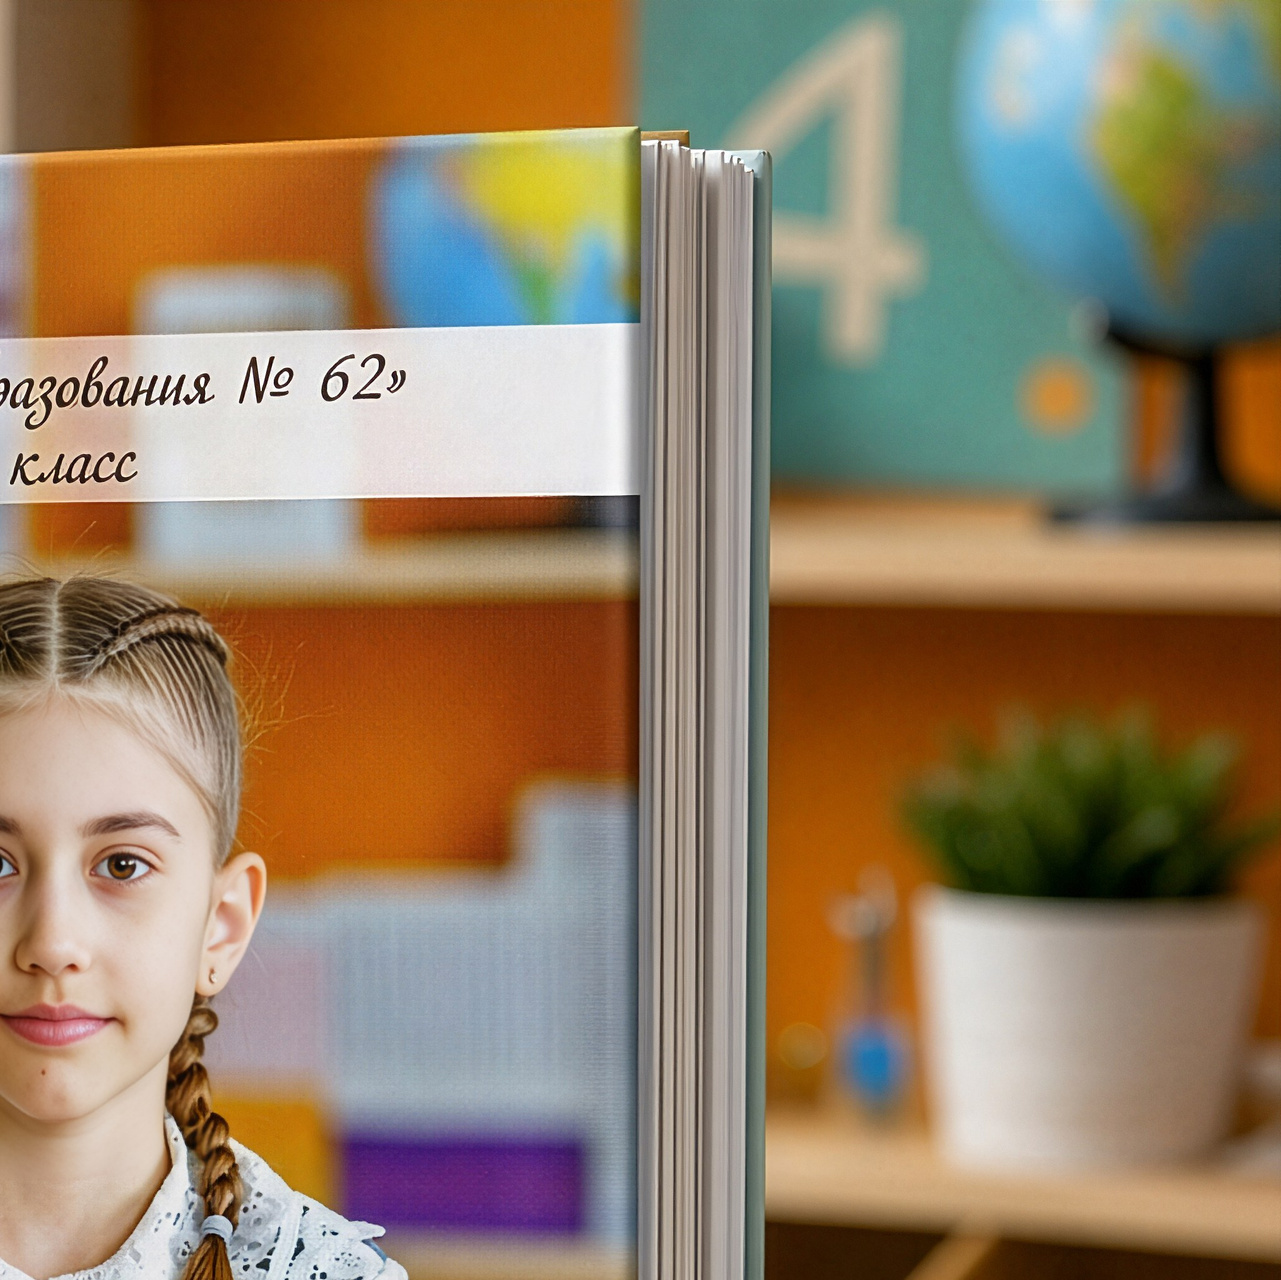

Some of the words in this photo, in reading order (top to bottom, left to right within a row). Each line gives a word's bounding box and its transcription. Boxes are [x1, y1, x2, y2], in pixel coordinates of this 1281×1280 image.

[239, 356, 295, 405] №
[321, 353, 407, 402] 62»
[9, 450, 138, 486] класс
